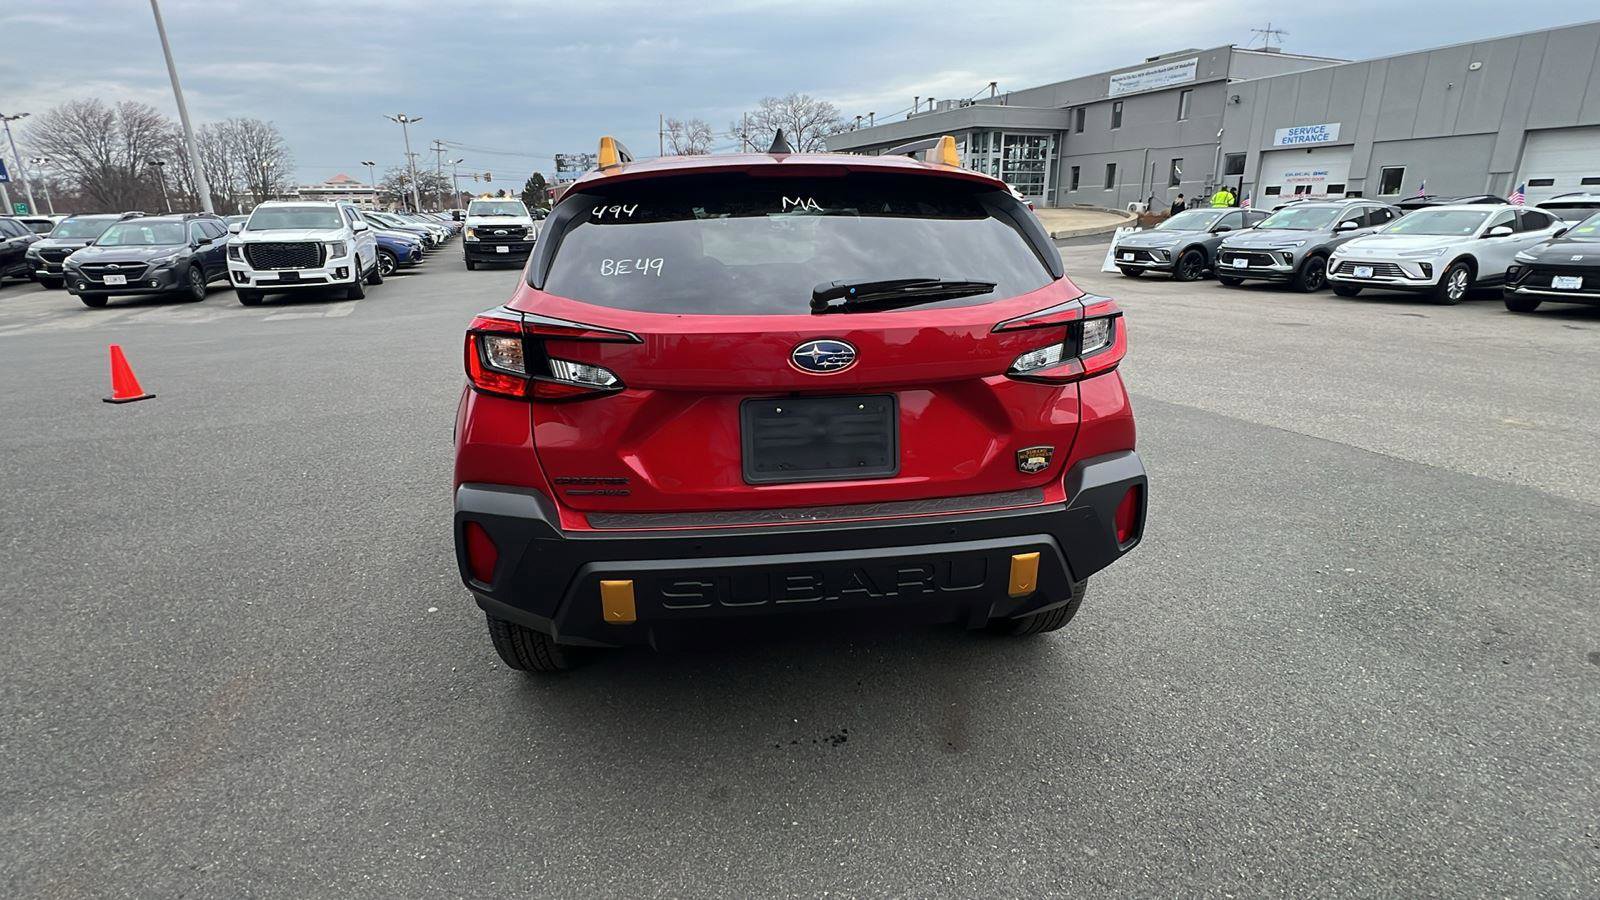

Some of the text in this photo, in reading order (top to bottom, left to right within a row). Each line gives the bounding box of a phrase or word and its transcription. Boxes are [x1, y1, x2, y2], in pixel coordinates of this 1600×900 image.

[1282, 133, 1330, 144] ENTRANCE
[1288, 126, 1326, 136] SERVICE
[592, 204, 638, 219] 494
[782, 196, 824, 212] MA
[661, 556, 988, 611] SUBARU
